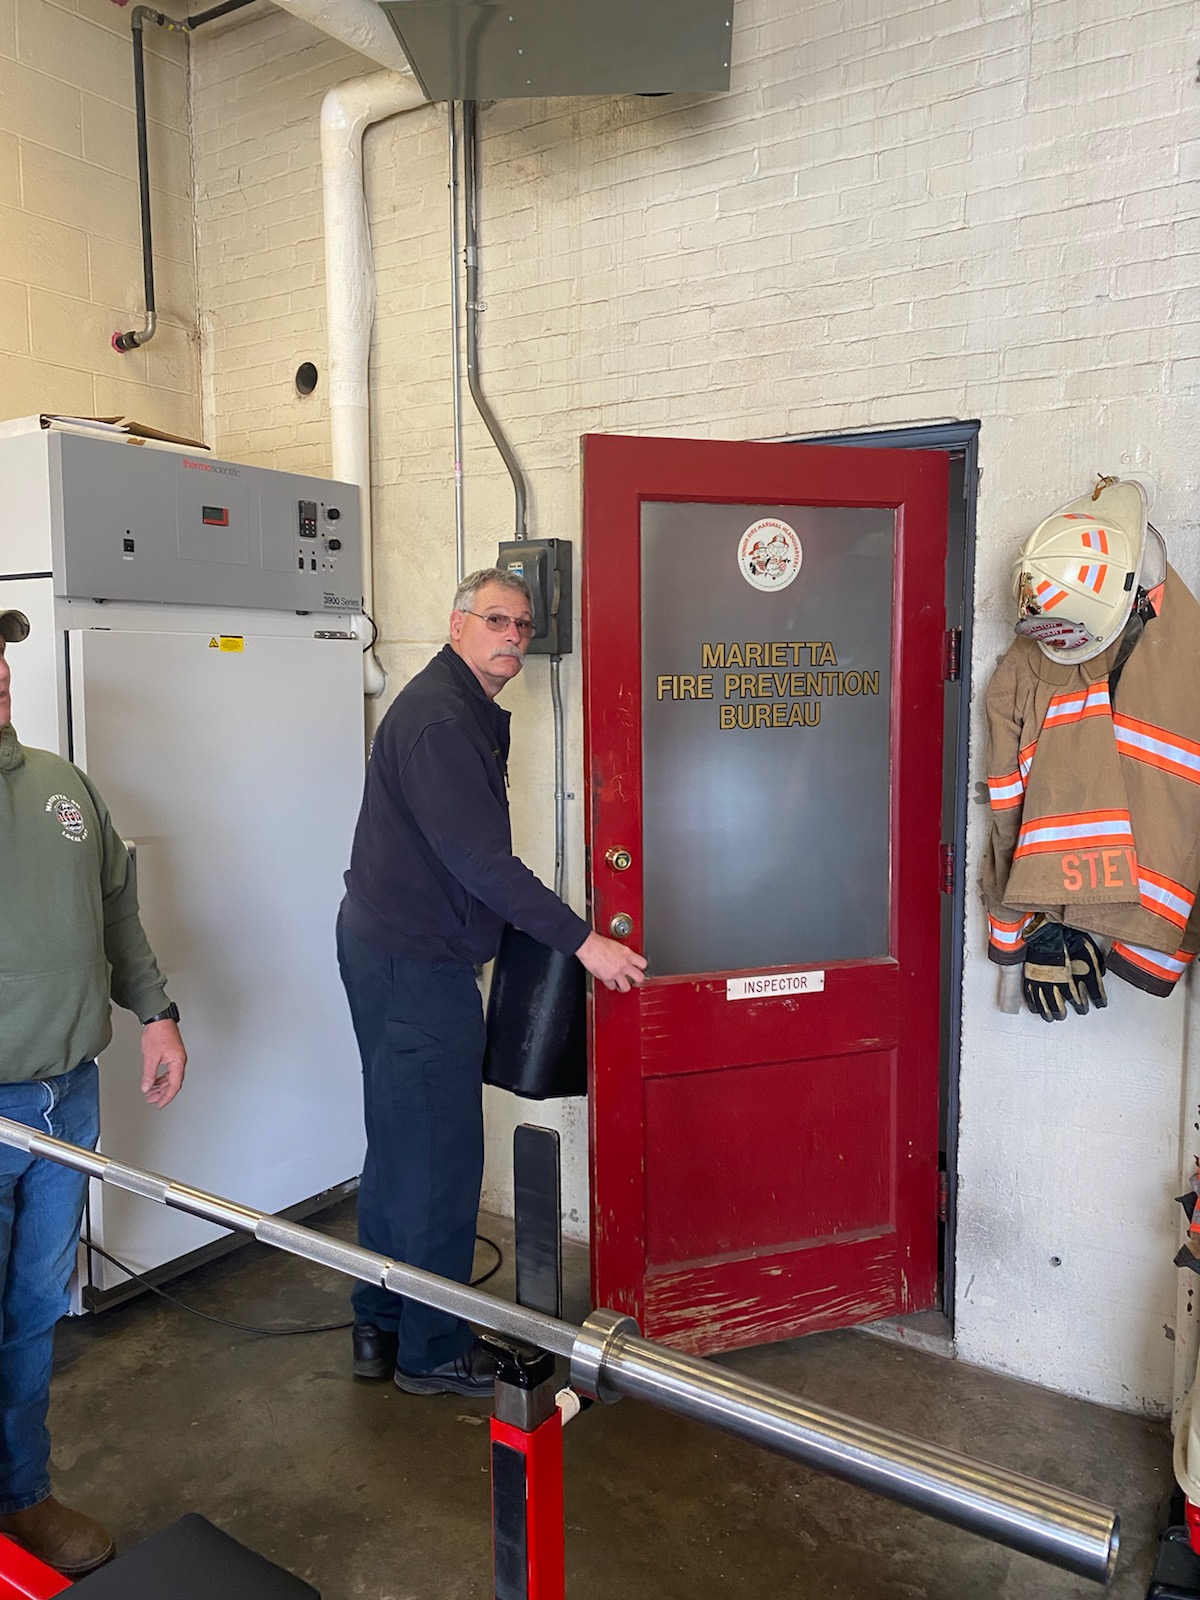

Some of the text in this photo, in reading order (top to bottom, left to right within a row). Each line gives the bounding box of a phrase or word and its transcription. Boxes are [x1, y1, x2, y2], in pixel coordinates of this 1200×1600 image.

[748, 527, 758, 539] FIRE
[758, 521, 782, 530] MARSHAL
[323, 595, 340, 605] 3900
[341, 596, 360, 607] Series
[702, 642, 837, 668] MARIETTA
[656, 671, 880, 700] FIRE PREVENTION
[719, 702, 821, 730] BUREAU
[743, 976, 808, 994] INSPECTOR
